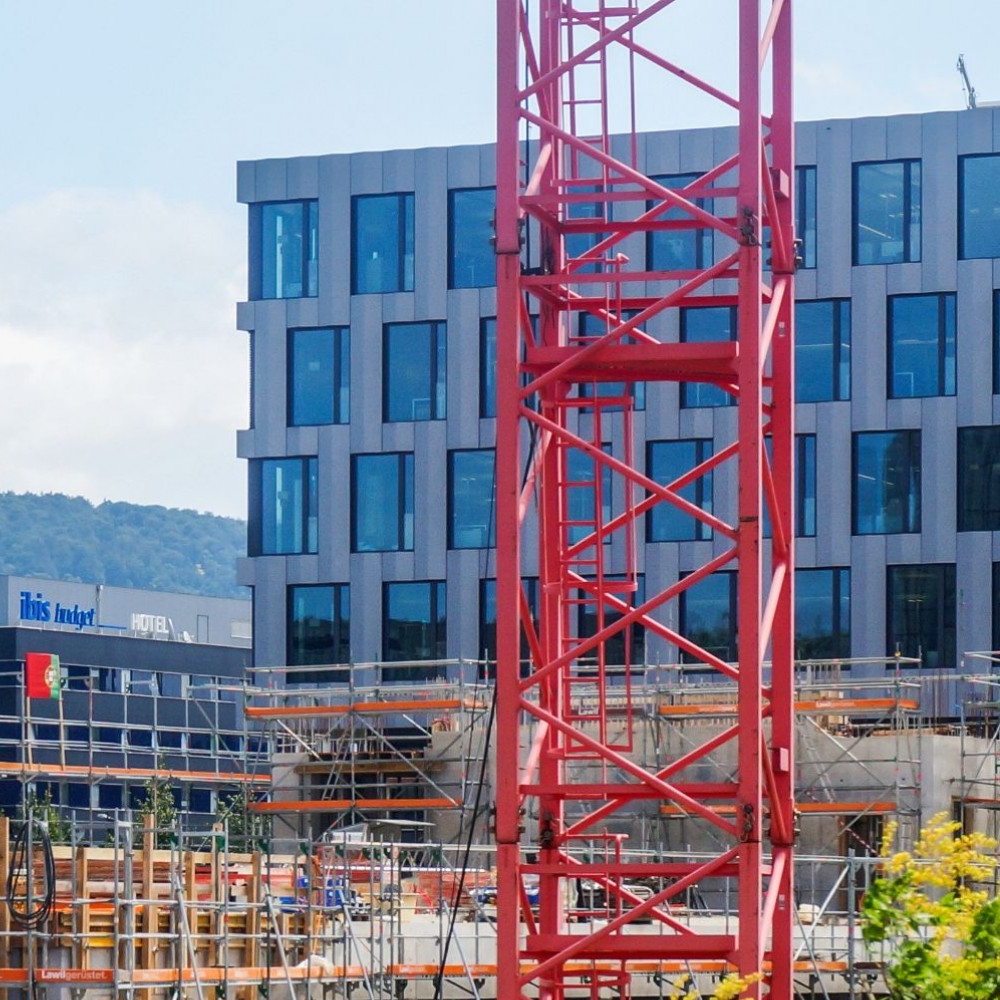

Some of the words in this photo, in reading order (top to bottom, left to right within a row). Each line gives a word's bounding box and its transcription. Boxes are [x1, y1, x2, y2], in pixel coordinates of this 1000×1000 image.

[20, 591, 51, 623] ibis
[54, 602, 99, 631] budget
[132, 612, 169, 634] HOTEL
